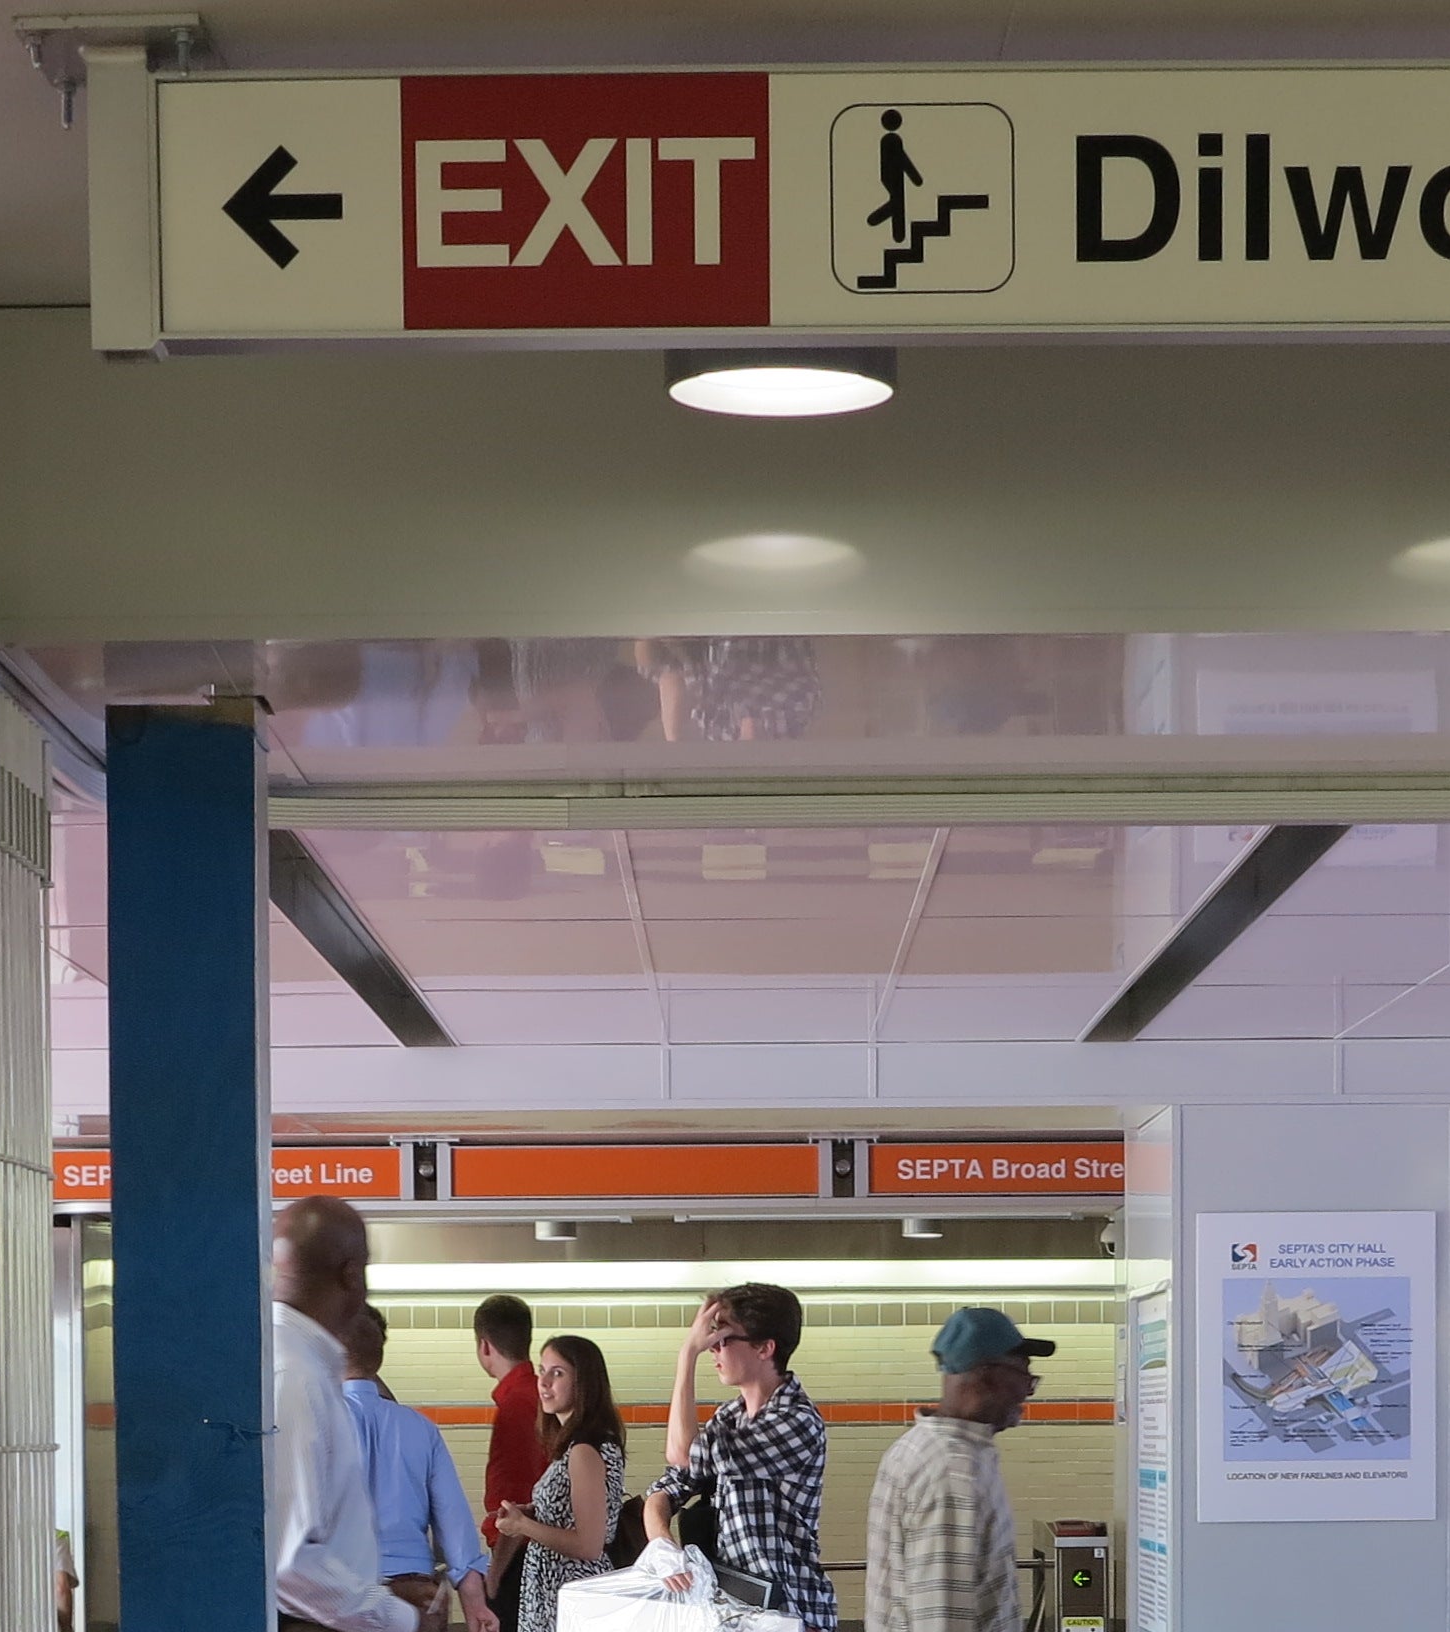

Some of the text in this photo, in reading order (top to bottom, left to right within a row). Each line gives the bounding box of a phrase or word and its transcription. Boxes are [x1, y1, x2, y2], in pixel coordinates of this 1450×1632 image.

[415, 137, 756, 268] EXIT
[320, 1163, 374, 1184] Line
[897, 1158, 1124, 1180] SEPTA Broad Stre
[1278, 1243, 1387, 1255] SEPTA'S CITY HALL
[1269, 1257, 1396, 1269] EARLY ACTION PHASE
[1226, 1470, 1409, 1481] LOCATION OF NEW FARELINES AND ELEVATORS
[1066, 1618, 1100, 1626] CAUTION
